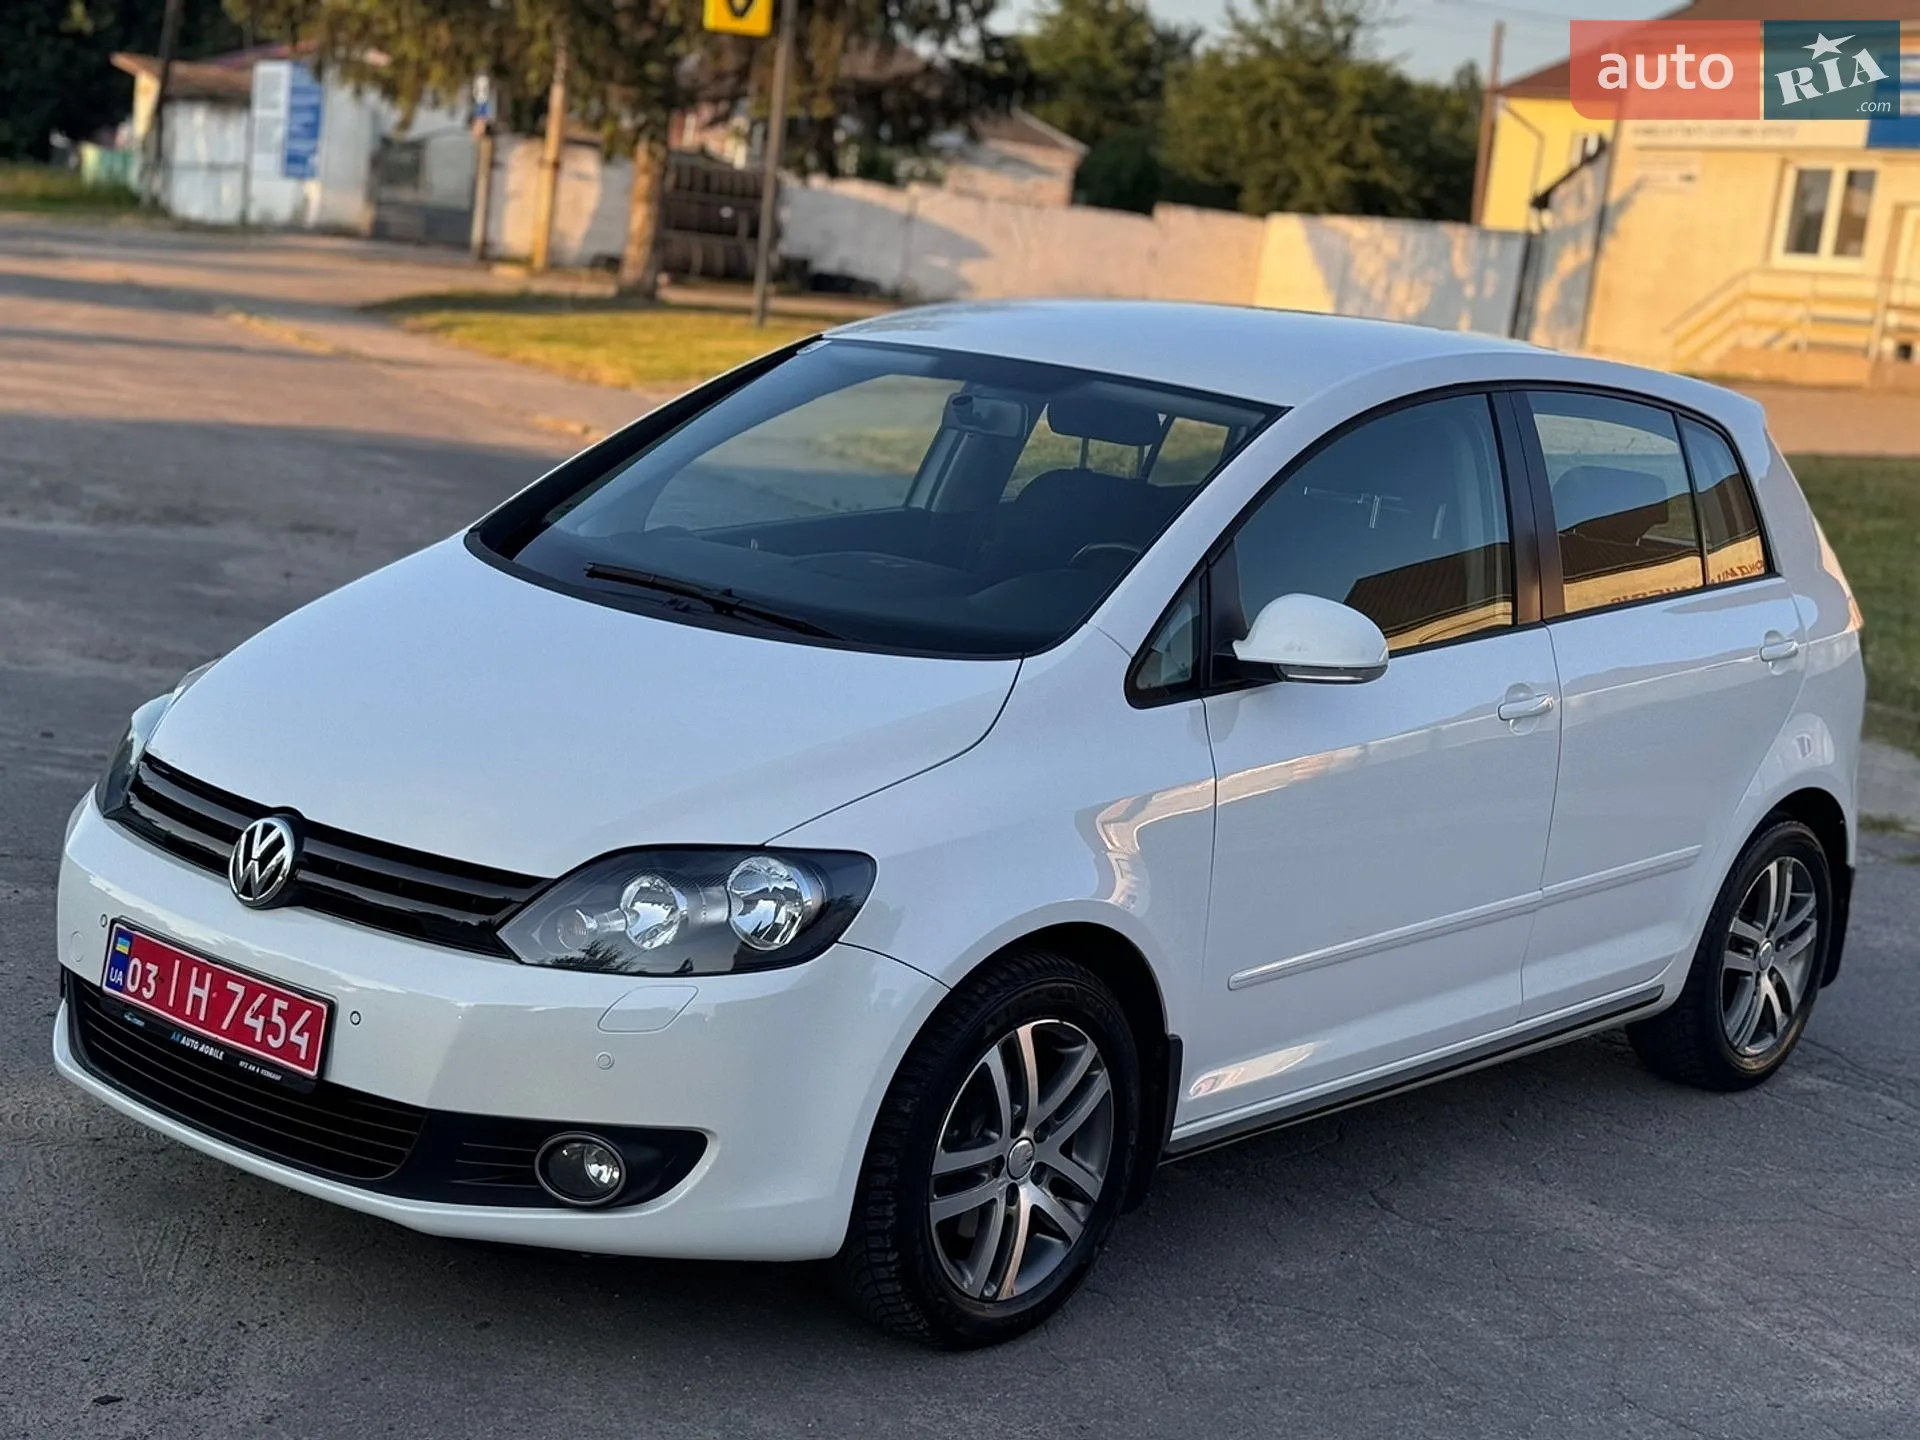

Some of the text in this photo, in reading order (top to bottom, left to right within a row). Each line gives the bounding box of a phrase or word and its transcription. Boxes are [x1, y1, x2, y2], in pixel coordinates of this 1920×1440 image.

[109, 966, 124, 987] UA
[126, 957, 158, 999] 03
[220, 980, 312, 1061] 7454
